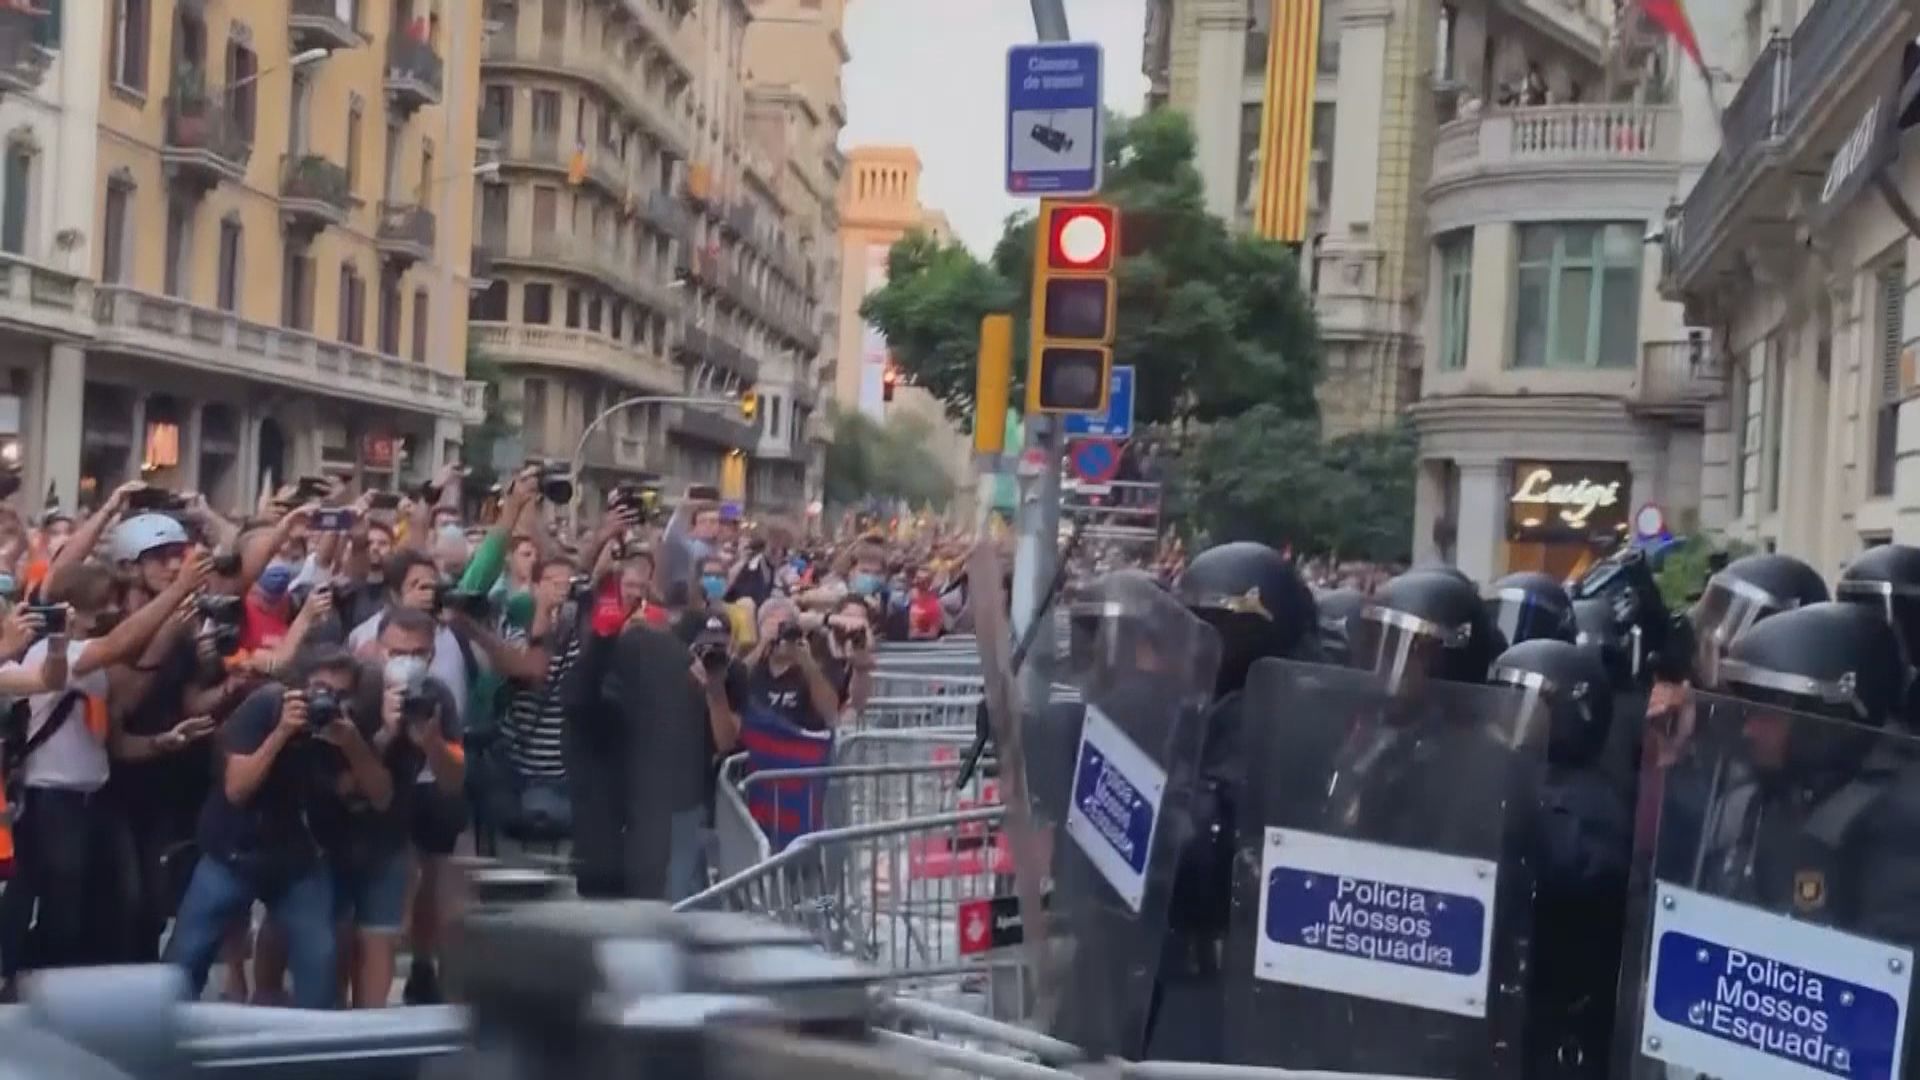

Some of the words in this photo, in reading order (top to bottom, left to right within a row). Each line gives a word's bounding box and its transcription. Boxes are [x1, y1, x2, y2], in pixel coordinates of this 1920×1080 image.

[1511, 469, 1620, 521] Luigi
[1329, 901, 1431, 938] Mossos
[1337, 876, 1426, 912] Policia
[1302, 921, 1453, 966] d'Esquadra
[1726, 949, 1823, 1002] Policia
[1716, 975, 1829, 1033] Mossos
[1688, 999, 1851, 1072] d'Esquadra
